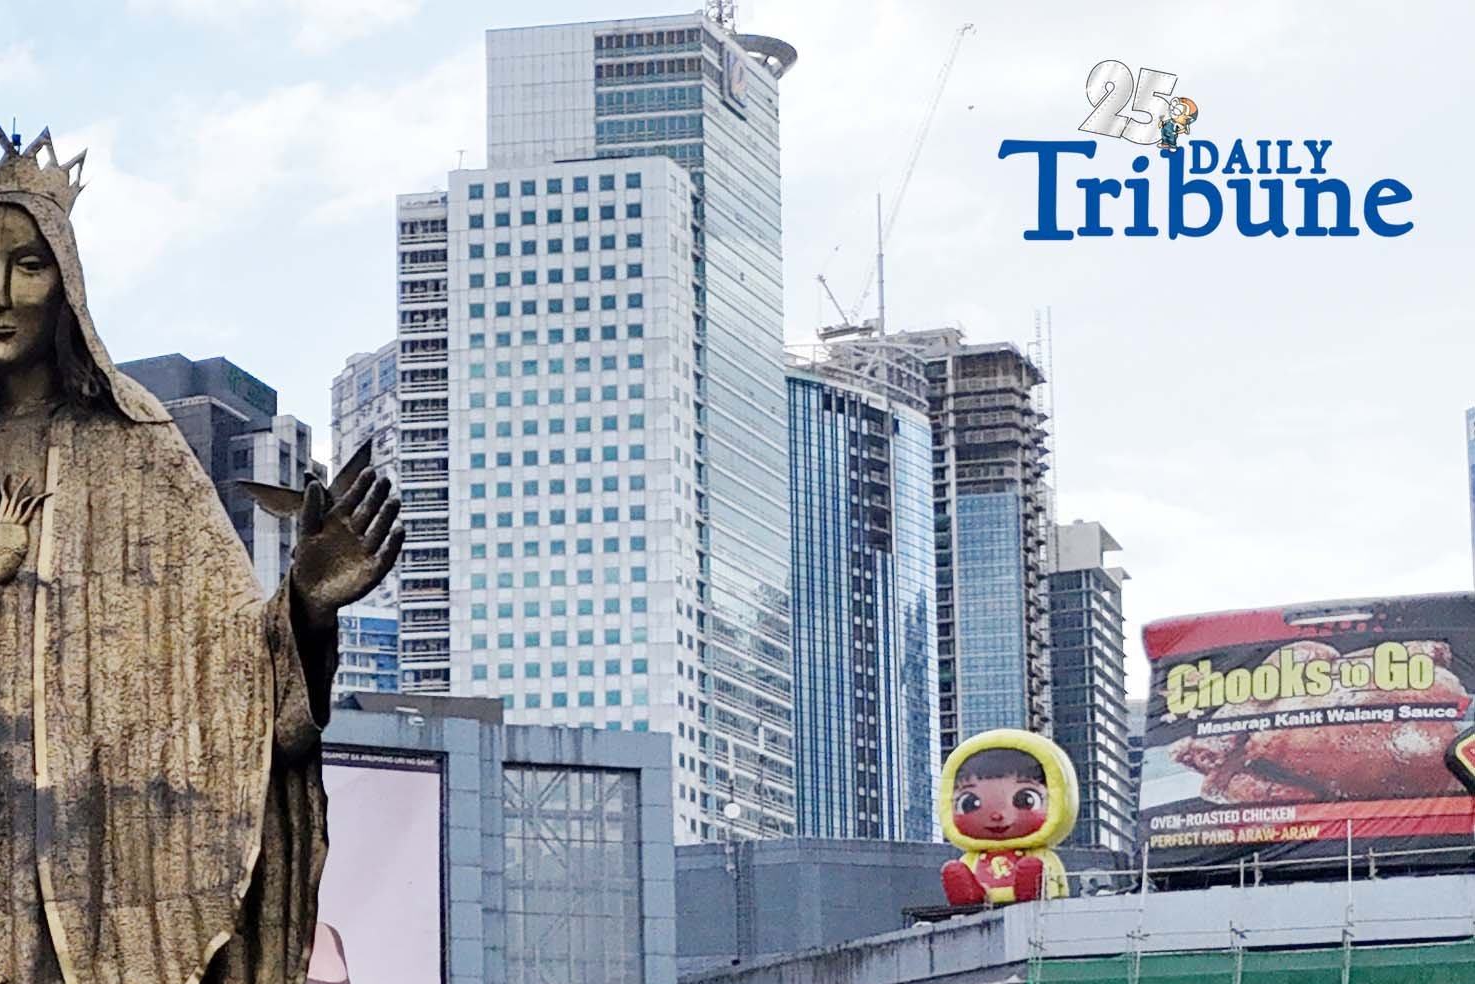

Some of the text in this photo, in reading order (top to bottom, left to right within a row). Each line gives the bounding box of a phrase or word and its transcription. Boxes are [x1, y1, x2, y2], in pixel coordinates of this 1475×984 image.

[1165, 641, 1435, 714] Chooks to Go
[1197, 716, 1271, 738] Masarap
[1275, 708, 1323, 728] Kahit
[1326, 704, 1393, 724] Walang
[1150, 805, 1297, 831] OVEN-ROASTED CHICKEN
[1150, 831, 1201, 850] PERFECT
[1237, 824, 1320, 844] ARAW-ARAW
